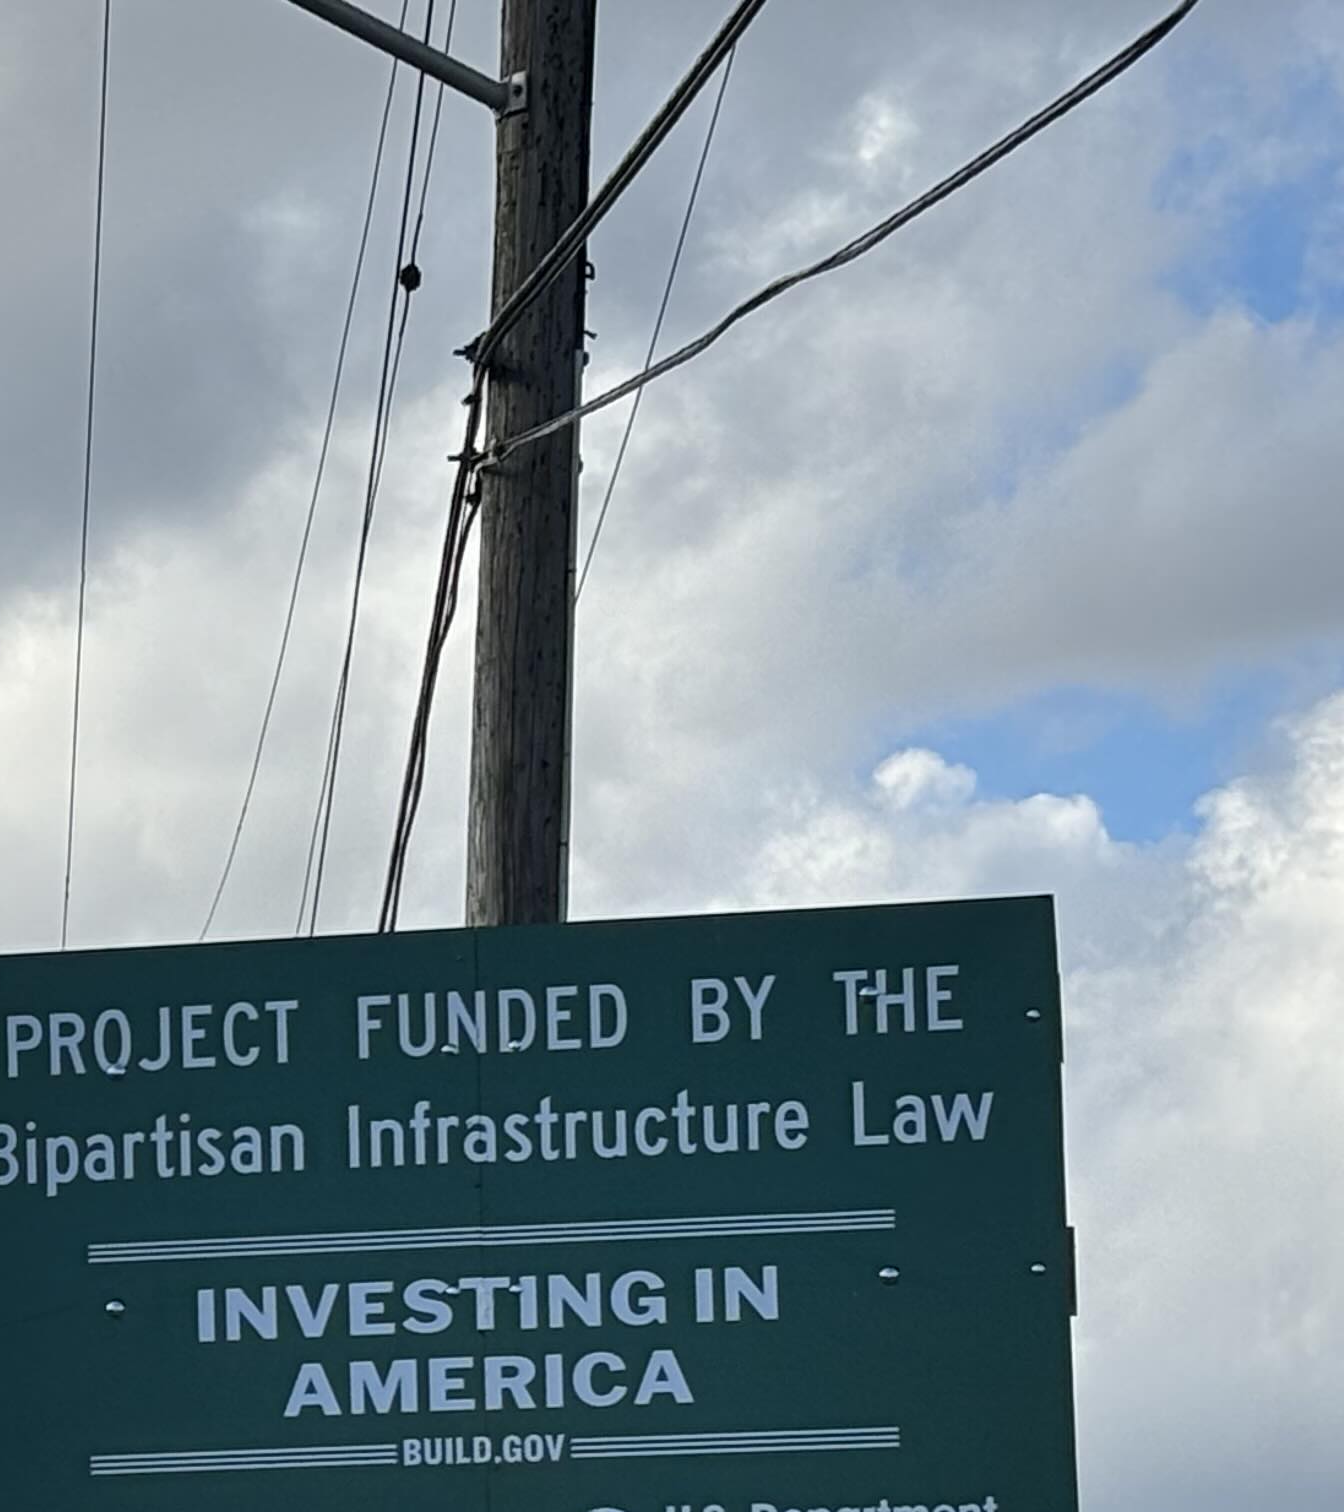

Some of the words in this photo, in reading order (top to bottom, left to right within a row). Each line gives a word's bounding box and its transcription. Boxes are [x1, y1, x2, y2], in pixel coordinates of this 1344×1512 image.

[6, 999, 300, 1080] PROJECT
[356, 984, 628, 1060] FUNDED
[690, 974, 777, 1044] BY
[832, 964, 965, 1035] THE
[347, 1088, 810, 1170] Infrastructure
[851, 1080, 995, 1147] Law
[196, 1269, 668, 1344] INVESTING
[695, 1265, 780, 1324] IN
[282, 1348, 696, 1418] AMERICA
[402, 1432, 566, 1467] BUILD.GOV
